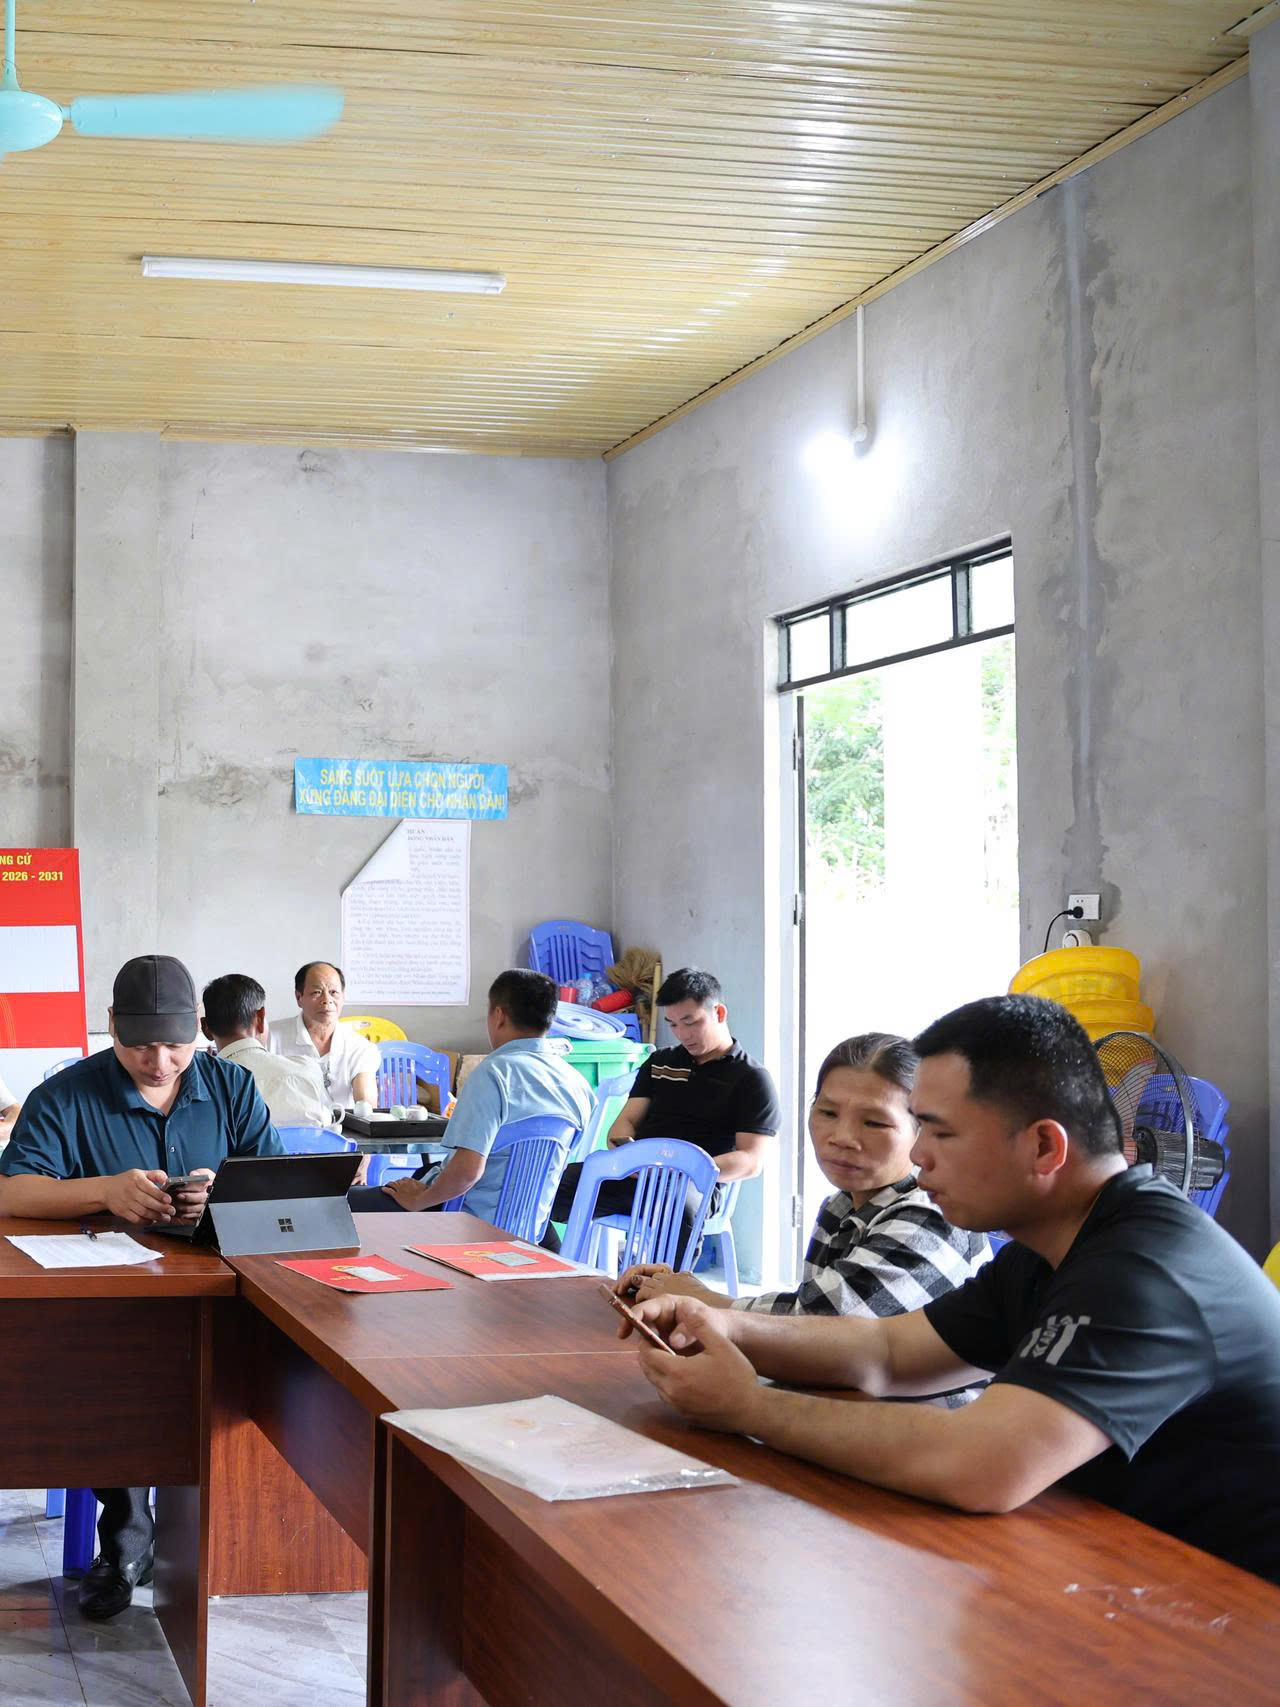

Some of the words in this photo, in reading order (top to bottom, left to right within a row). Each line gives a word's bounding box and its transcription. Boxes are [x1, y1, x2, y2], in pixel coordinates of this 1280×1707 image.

[16, 852, 32, 865] CỬ
[2, 872, 28, 881] 2026
[38, 871, 63, 881] 2031
